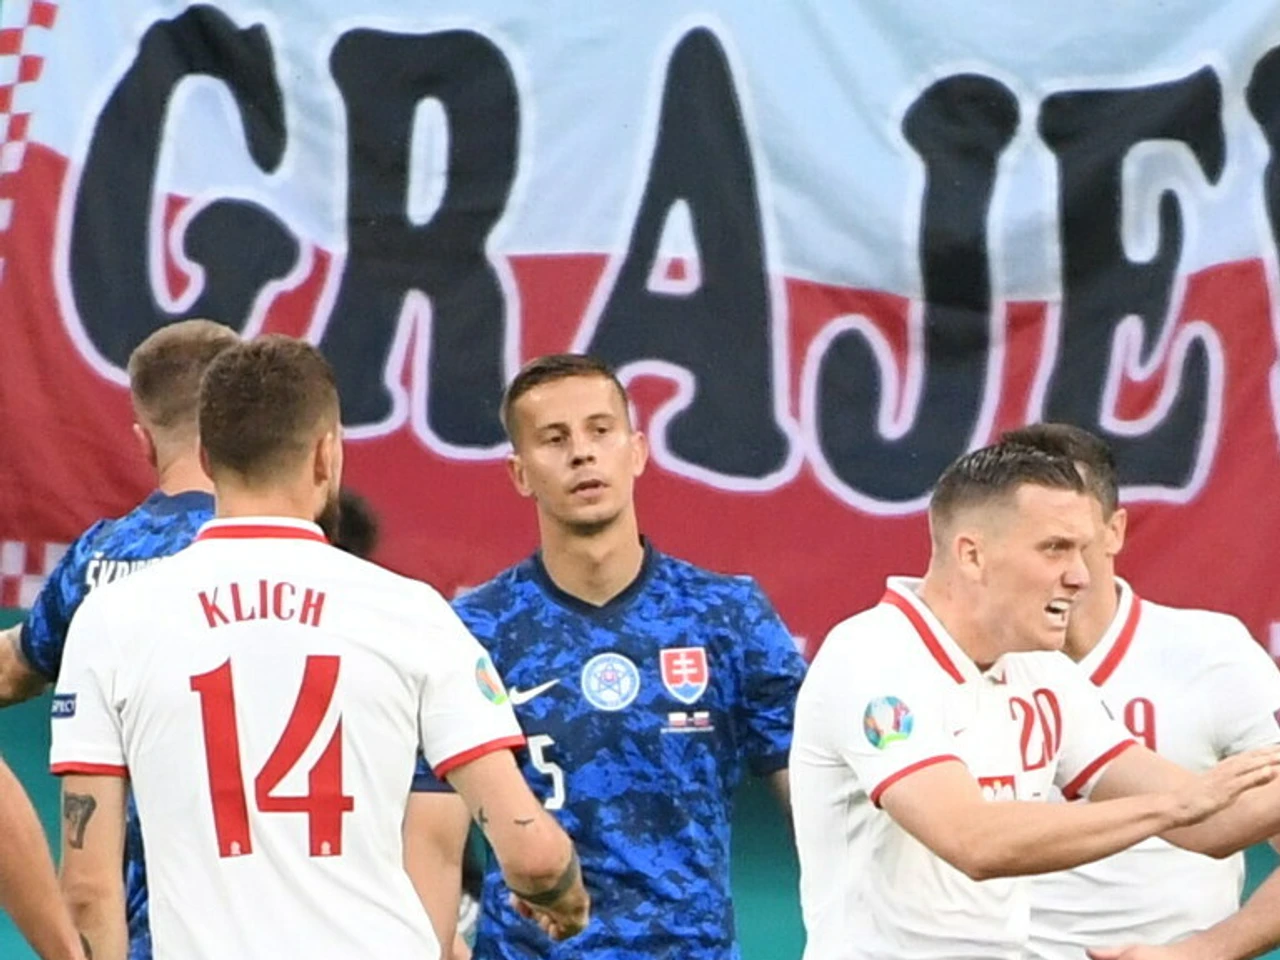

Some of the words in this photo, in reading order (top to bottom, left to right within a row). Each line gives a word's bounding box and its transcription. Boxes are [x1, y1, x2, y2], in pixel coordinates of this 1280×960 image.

[198, 579, 325, 628] KLICH
[190, 655, 354, 858] 14
[1008, 688, 1062, 772] 20
[1123, 697, 1157, 752] 9
[527, 734, 565, 809] 5
